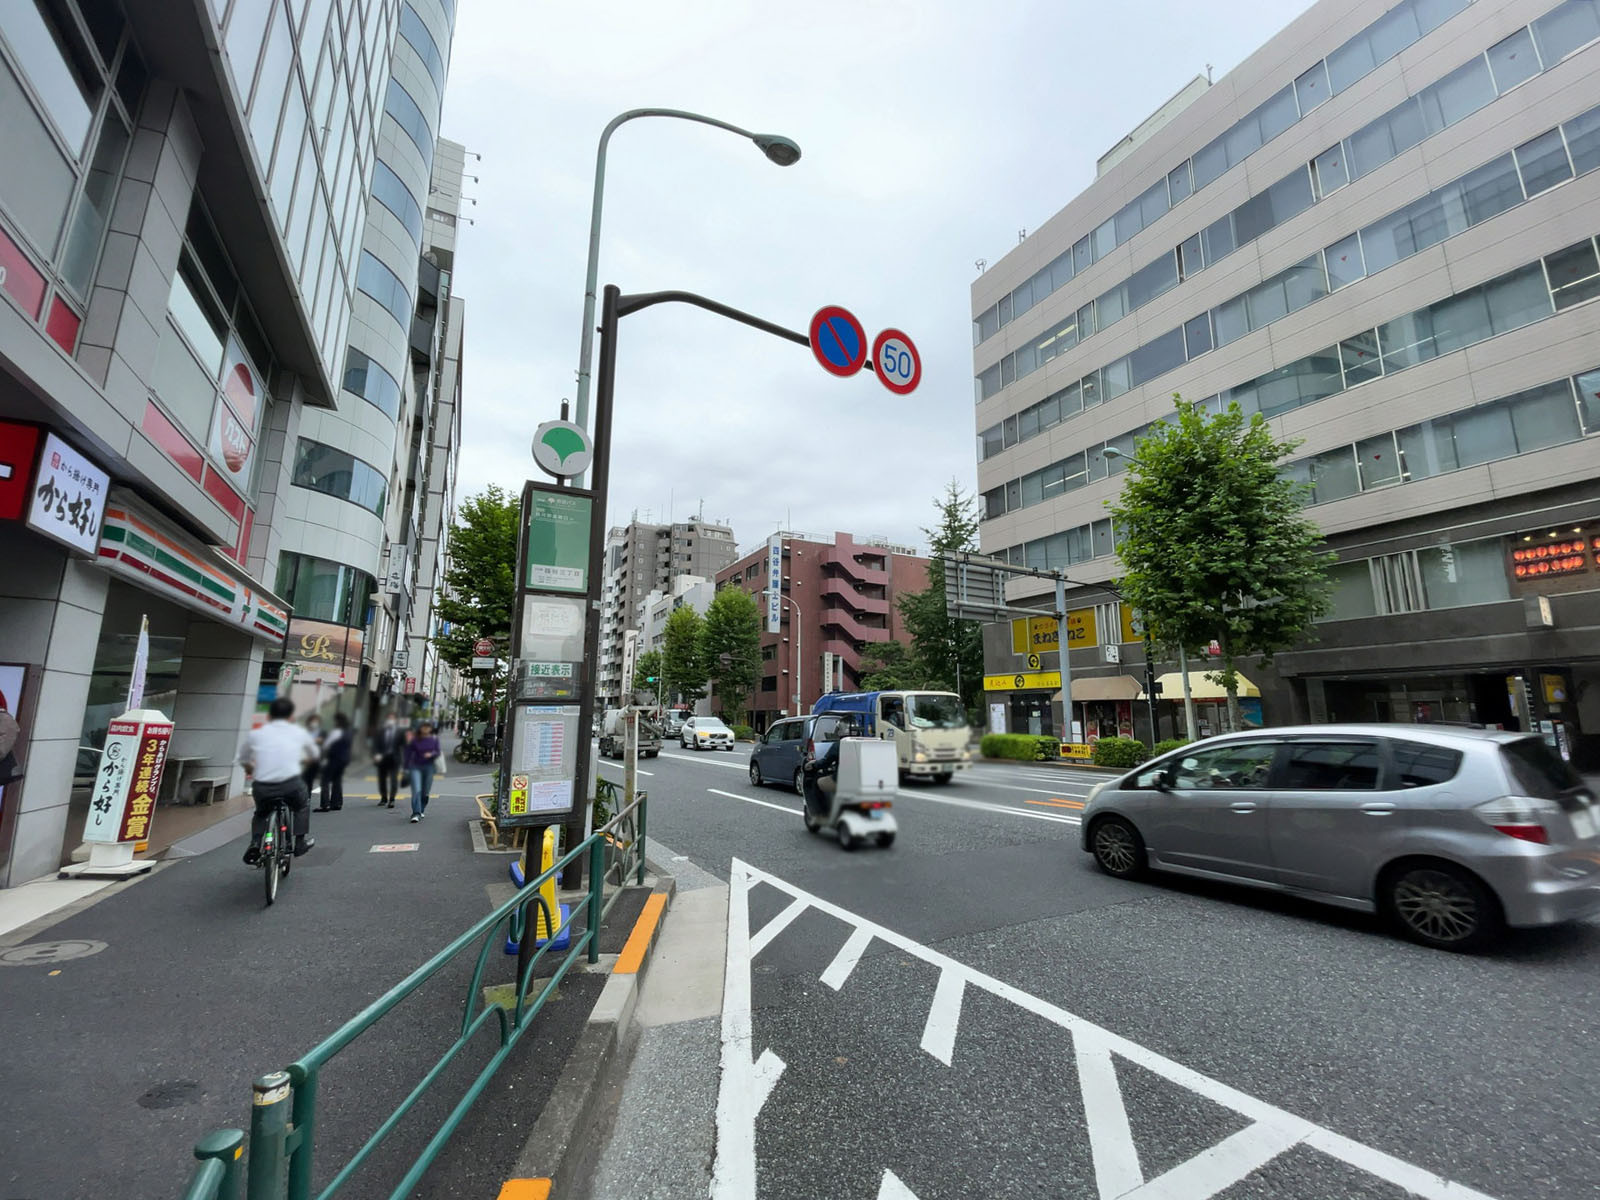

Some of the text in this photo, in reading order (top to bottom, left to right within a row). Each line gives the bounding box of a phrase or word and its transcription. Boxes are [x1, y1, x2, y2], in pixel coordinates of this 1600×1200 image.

[884, 343, 911, 379] 50
[38, 475, 97, 537] から好し
[530, 663, 571, 676] 接近表示
[93, 760, 119, 826] から好し
